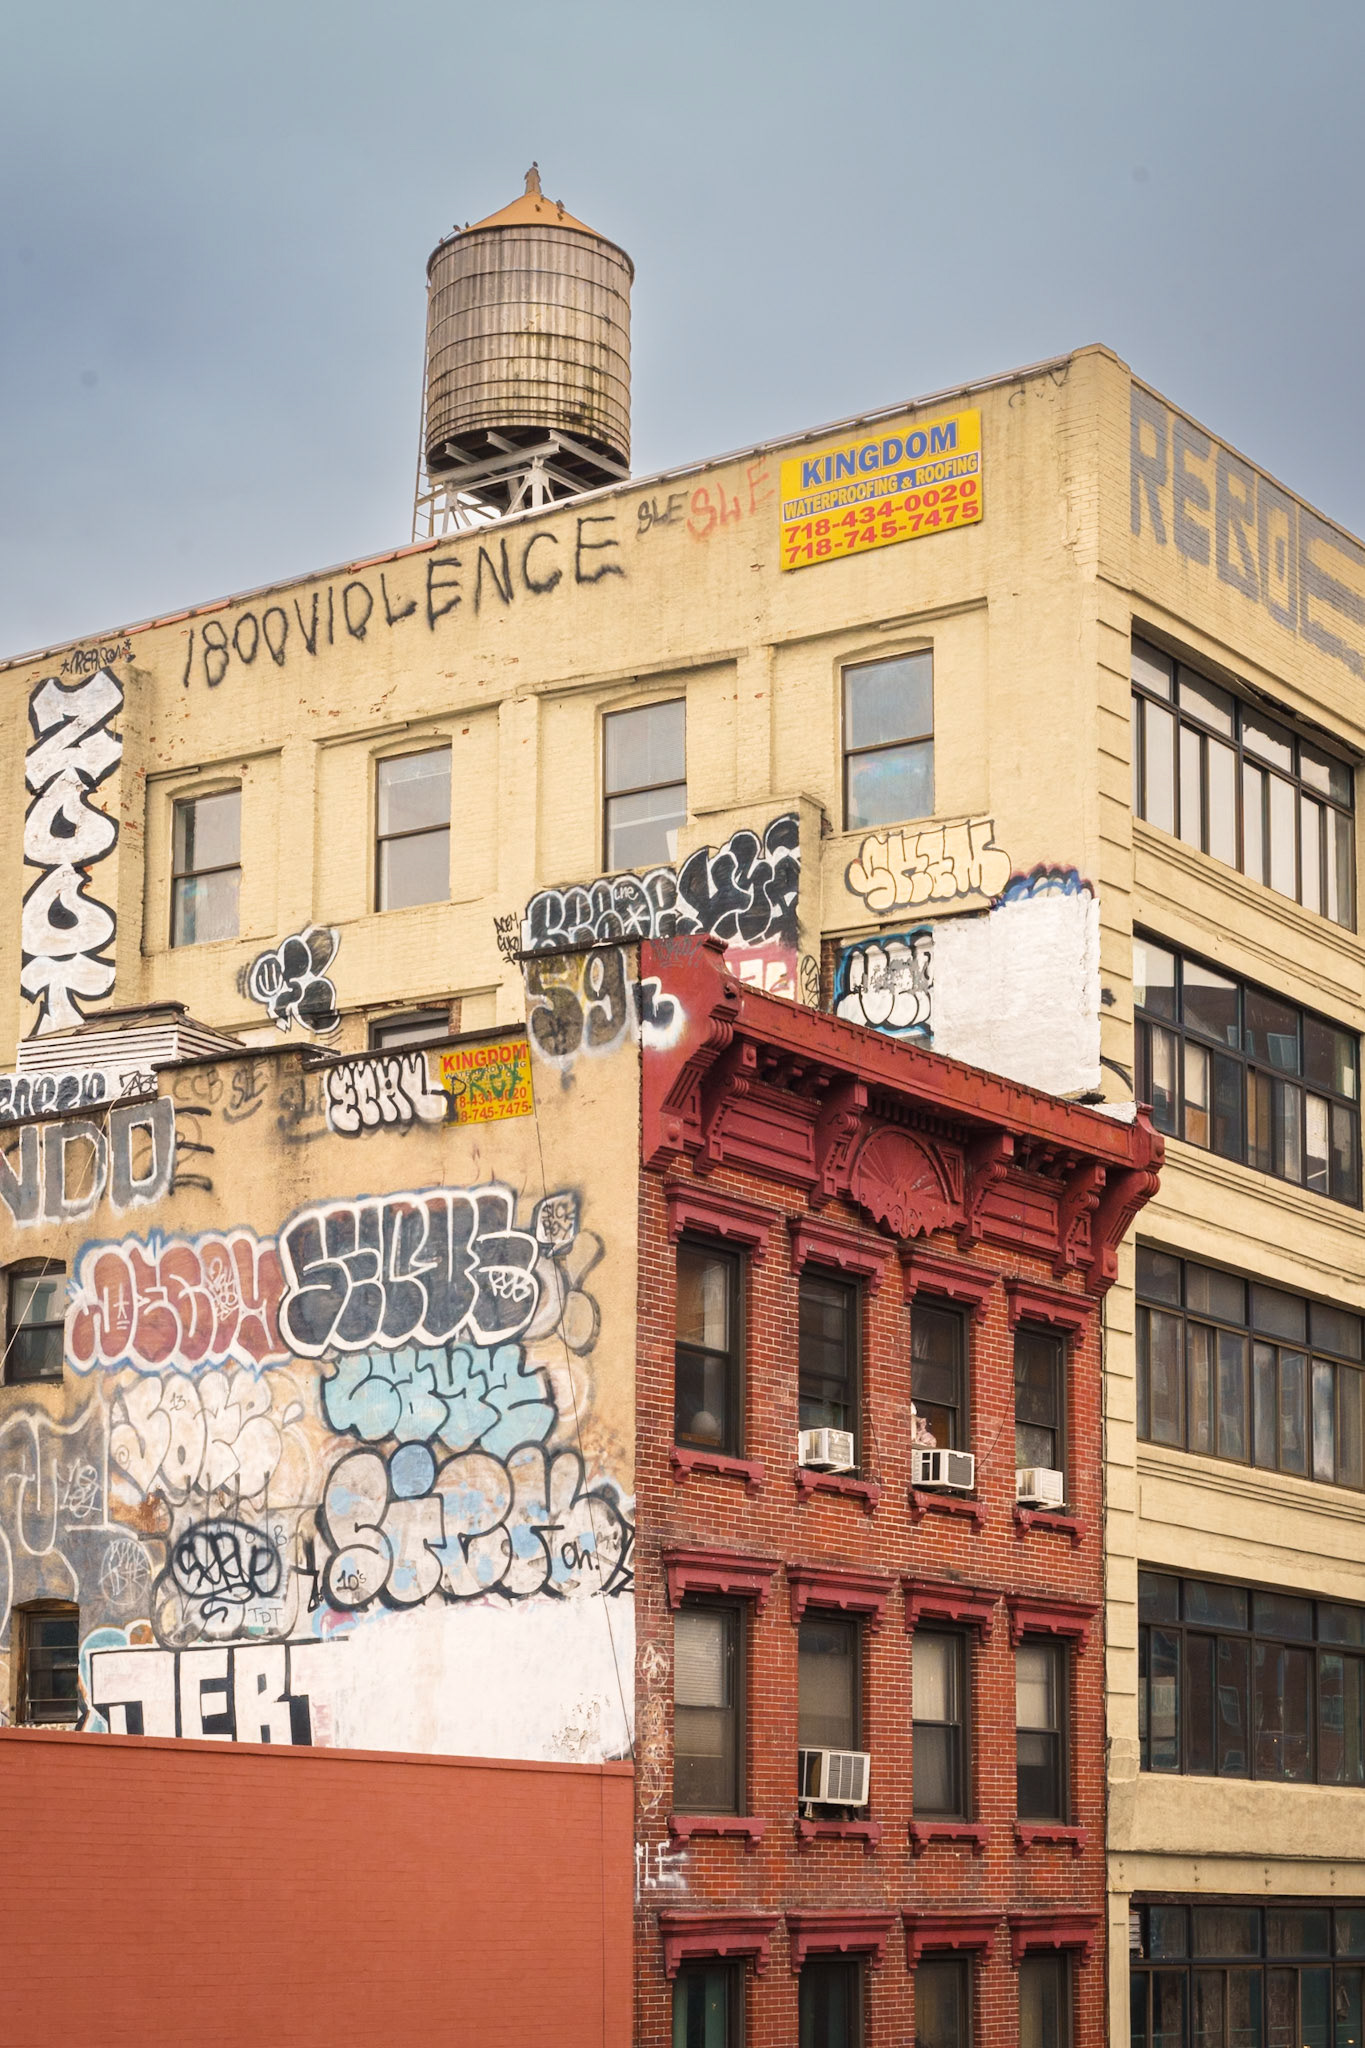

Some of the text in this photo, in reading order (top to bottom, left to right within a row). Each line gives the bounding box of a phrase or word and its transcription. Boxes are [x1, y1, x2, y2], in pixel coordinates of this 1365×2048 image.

[784, 454, 977, 519] WATERPROOFING & ROOFING
[802, 421, 958, 489] KINGDOM
[785, 480, 977, 544] 718-434-0020
[785, 500, 979, 564] 718-745-7475
[443, 1044, 527, 1072] KINGDOM
